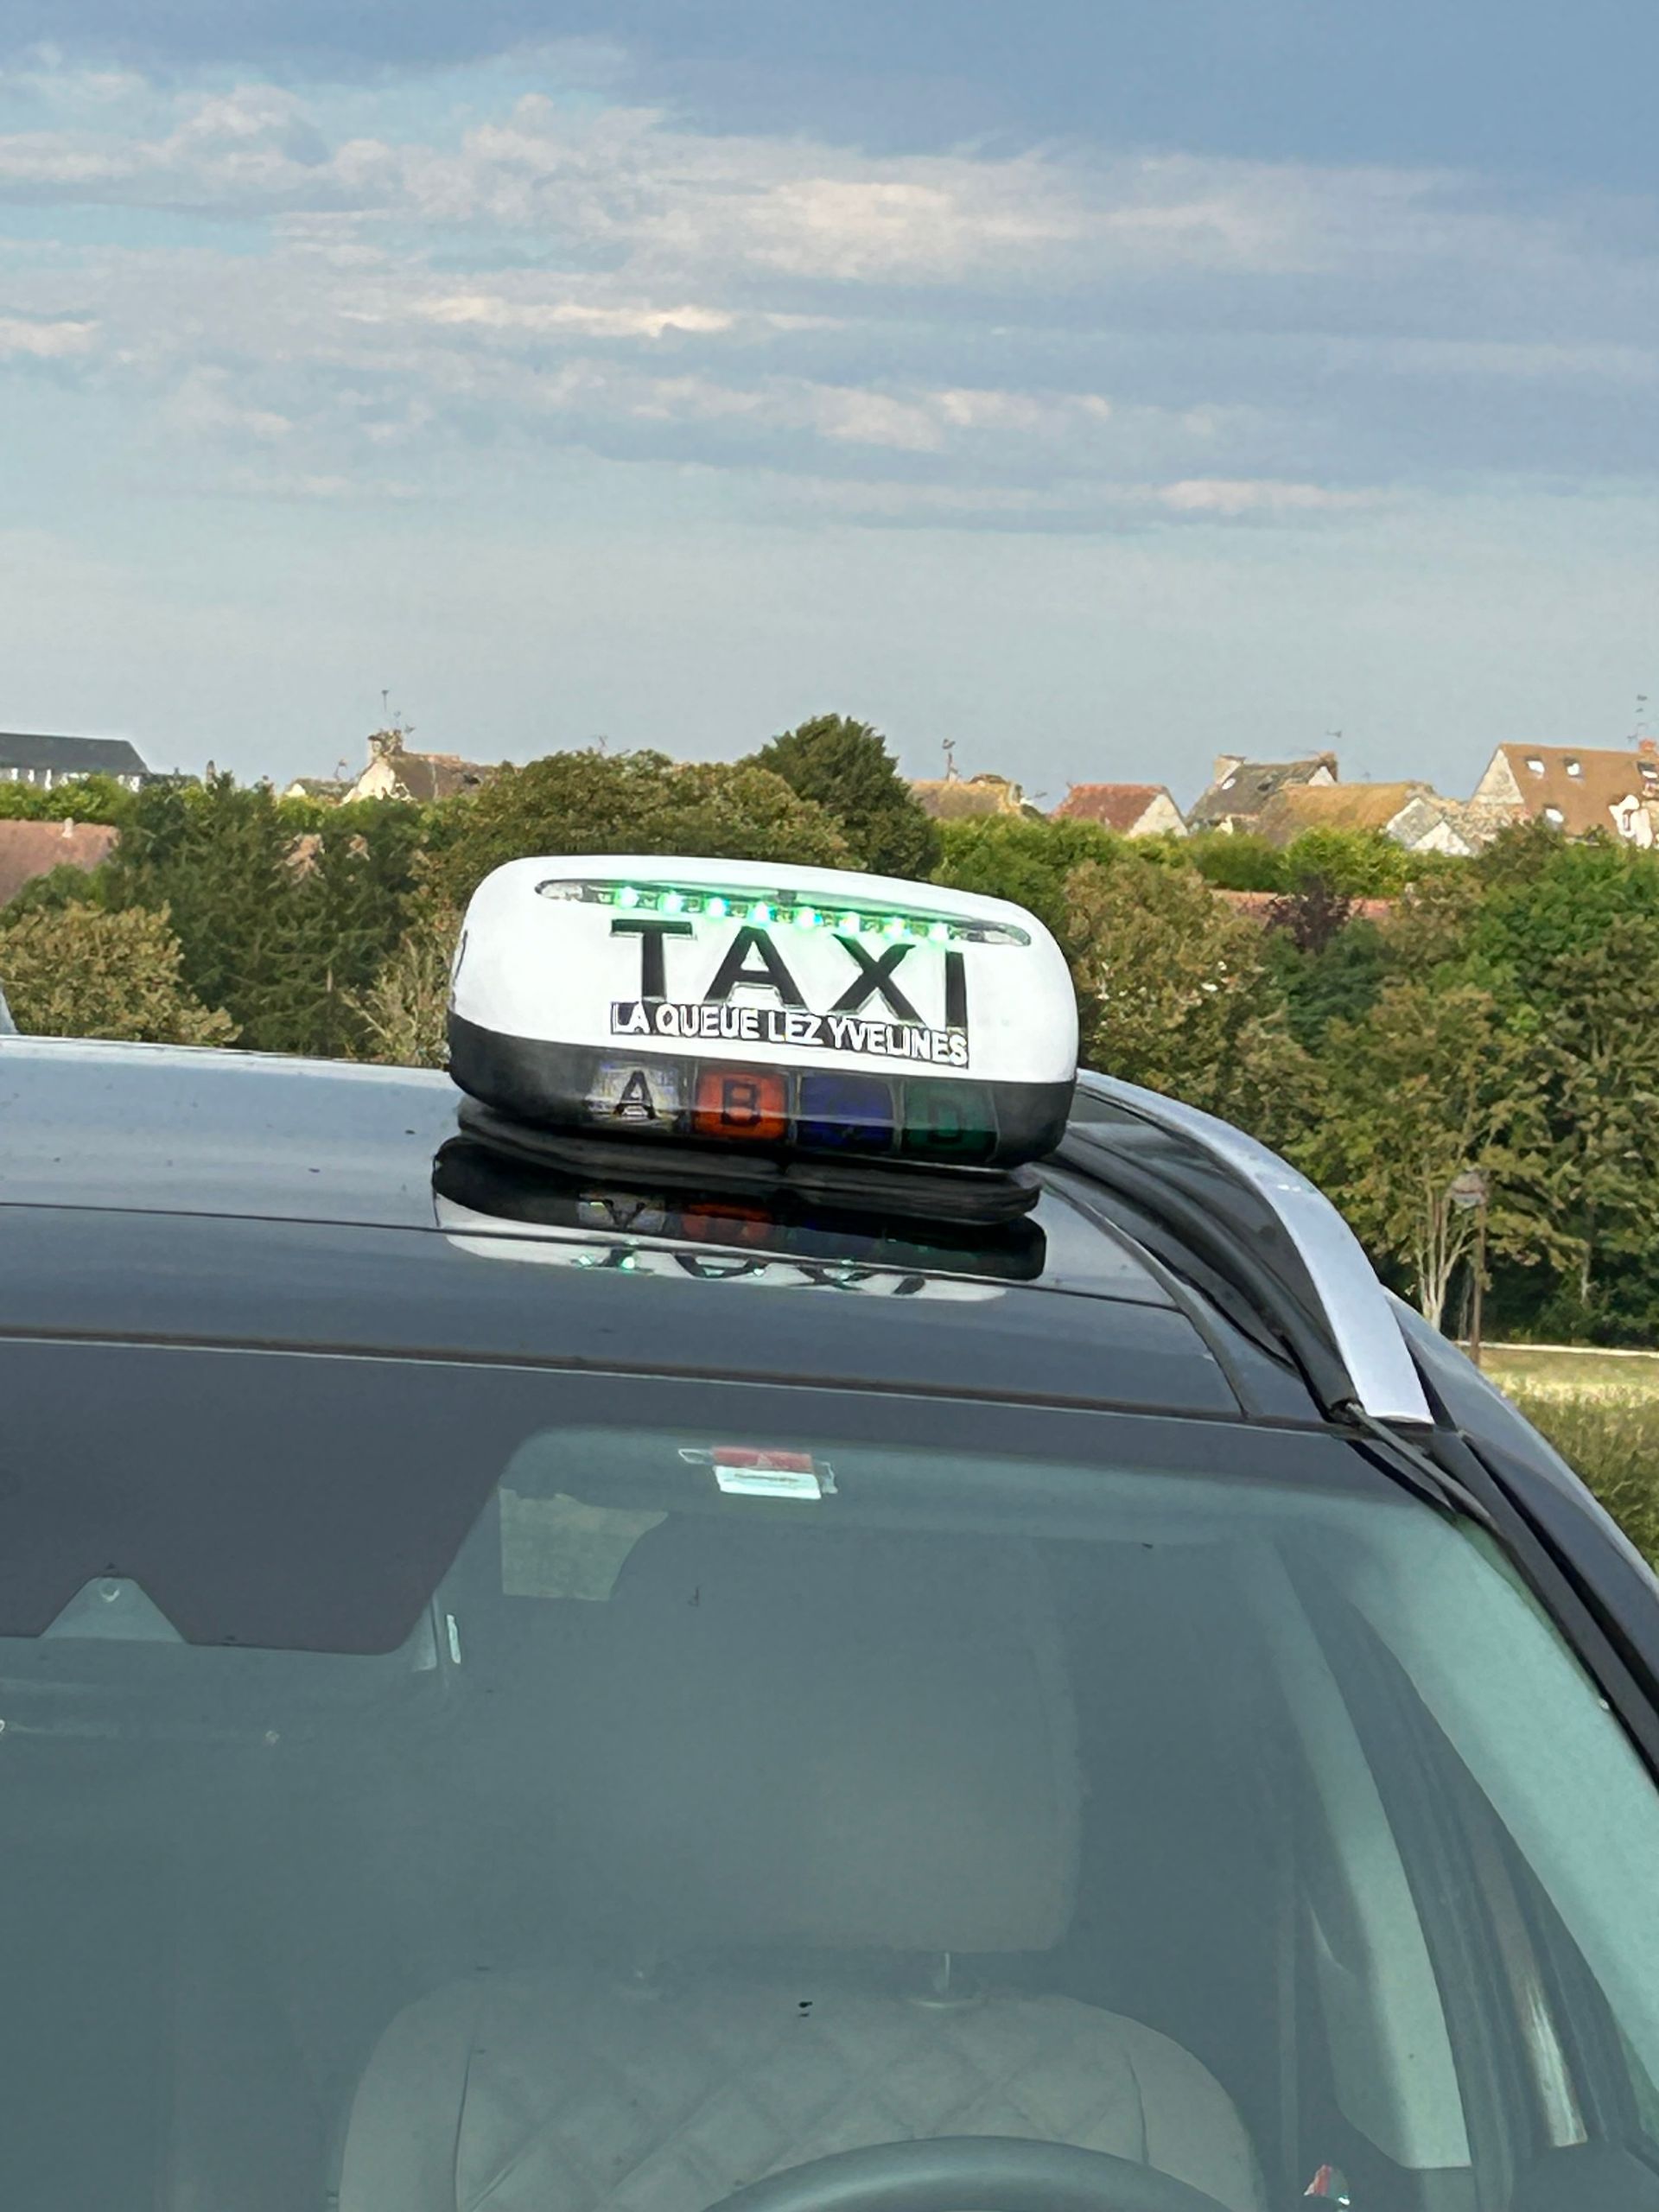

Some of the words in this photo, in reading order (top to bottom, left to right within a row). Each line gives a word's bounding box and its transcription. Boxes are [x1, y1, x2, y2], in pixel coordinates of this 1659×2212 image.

[611, 918, 969, 1028] TAXI
[613, 1001, 650, 1034] LA
[656, 1003, 760, 1039] QUEUE
[768, 1010, 824, 1045] LEZ
[828, 1015, 968, 1065] YVELINES
[613, 1070, 657, 1120] A
[721, 1080, 761, 1127] B
